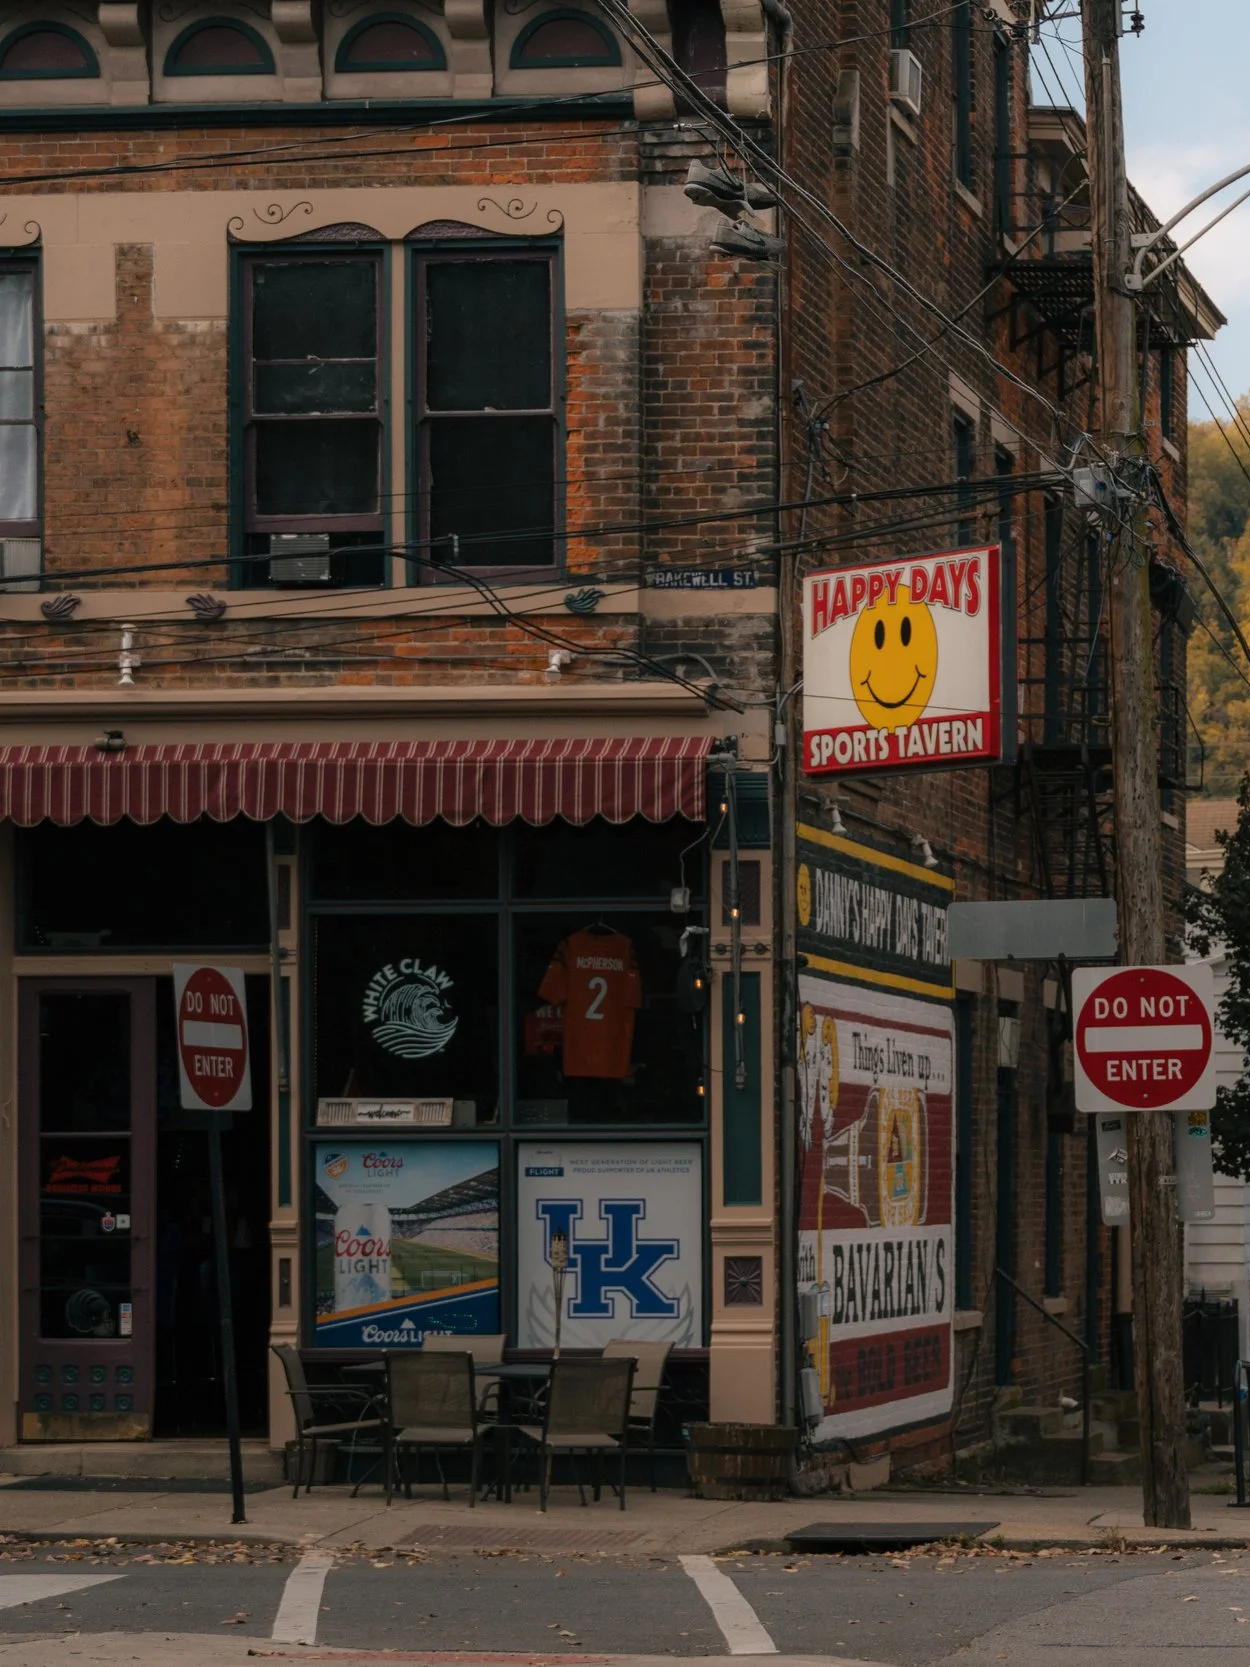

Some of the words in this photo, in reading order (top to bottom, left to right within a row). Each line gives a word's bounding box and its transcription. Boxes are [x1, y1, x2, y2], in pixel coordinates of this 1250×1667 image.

[811, 567, 905, 640] HAPPY
[909, 556, 981, 617] DAYS
[810, 728, 890, 768] SPORTS
[894, 717, 983, 758] TAVERN
[815, 867, 860, 944] DANNY'S
[861, 883, 893, 951] HAPPY
[896, 894, 918, 960] DAYS
[186, 990, 204, 1015] DO
[210, 991, 236, 1018] NOT
[361, 963, 398, 1023] WHITE
[399, 958, 454, 991] CLAW
[584, 976, 608, 1020] 2
[1094, 996, 1128, 1019] DO
[1140, 995, 1189, 1018] NOT
[193, 1054, 234, 1079] ENTER
[852, 1032, 885, 1084] Things
[886, 1038, 914, 1078] Liven
[1106, 1058, 1183, 1082] ENTER
[361, 1152, 403, 1169] Coors
[368, 1168, 399, 1177] LIGHT
[528, 1168, 559, 1176] FLIGHT
[335, 1229, 392, 1257] Coors
[340, 1259, 388, 1274] LIGHT
[536, 1198, 680, 1319] UK
[362, 1324, 409, 1343] Coors
